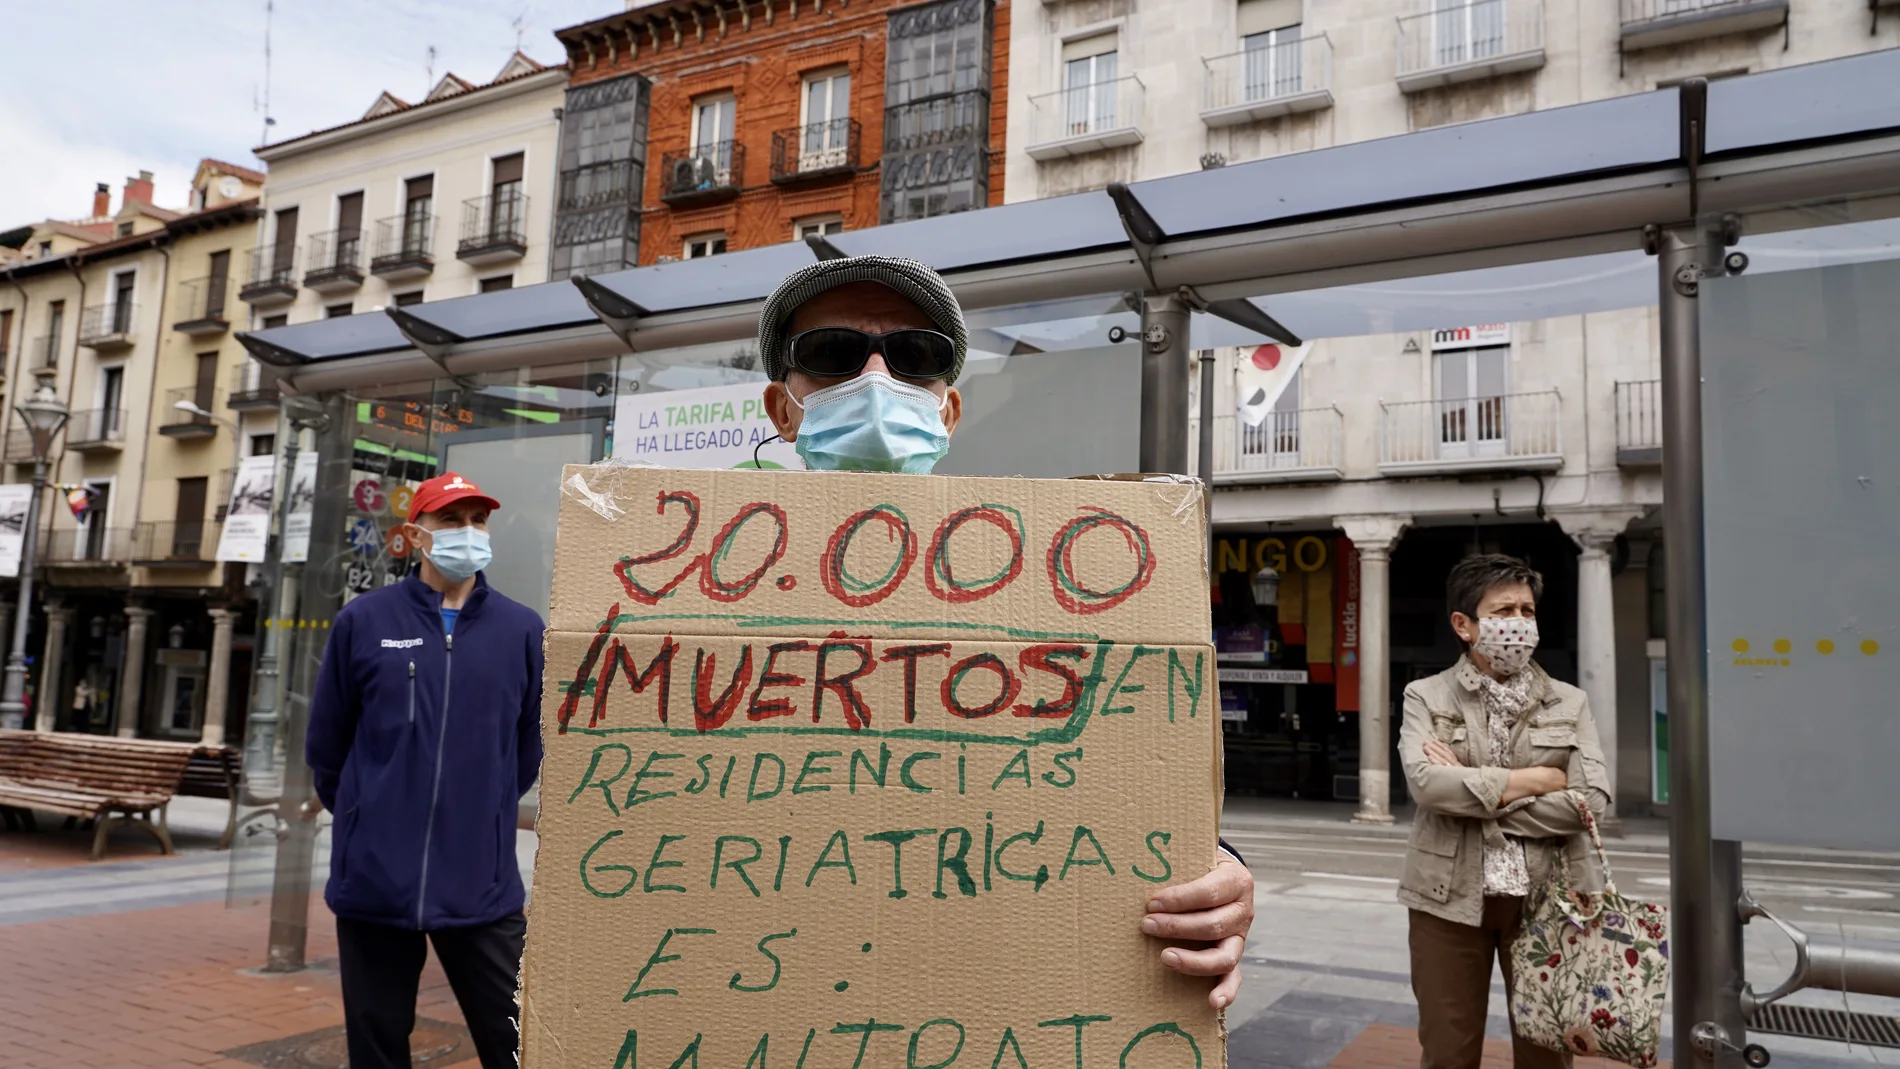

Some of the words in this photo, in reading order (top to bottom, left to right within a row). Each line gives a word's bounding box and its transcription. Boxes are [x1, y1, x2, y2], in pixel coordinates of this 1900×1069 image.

[639, 411, 659, 430] LA
[665, 399, 734, 427] TARIFA
[742, 398, 769, 421] PL
[636, 436, 658, 453] HA
[664, 428, 743, 452] LLEGADO
[748, 427, 772, 446] AL
[398, 492, 409, 511] 2
[613, 489, 1156, 614] 20.000
[1218, 536, 1327, 573] NGO
[1099, 644, 1203, 722] EN
